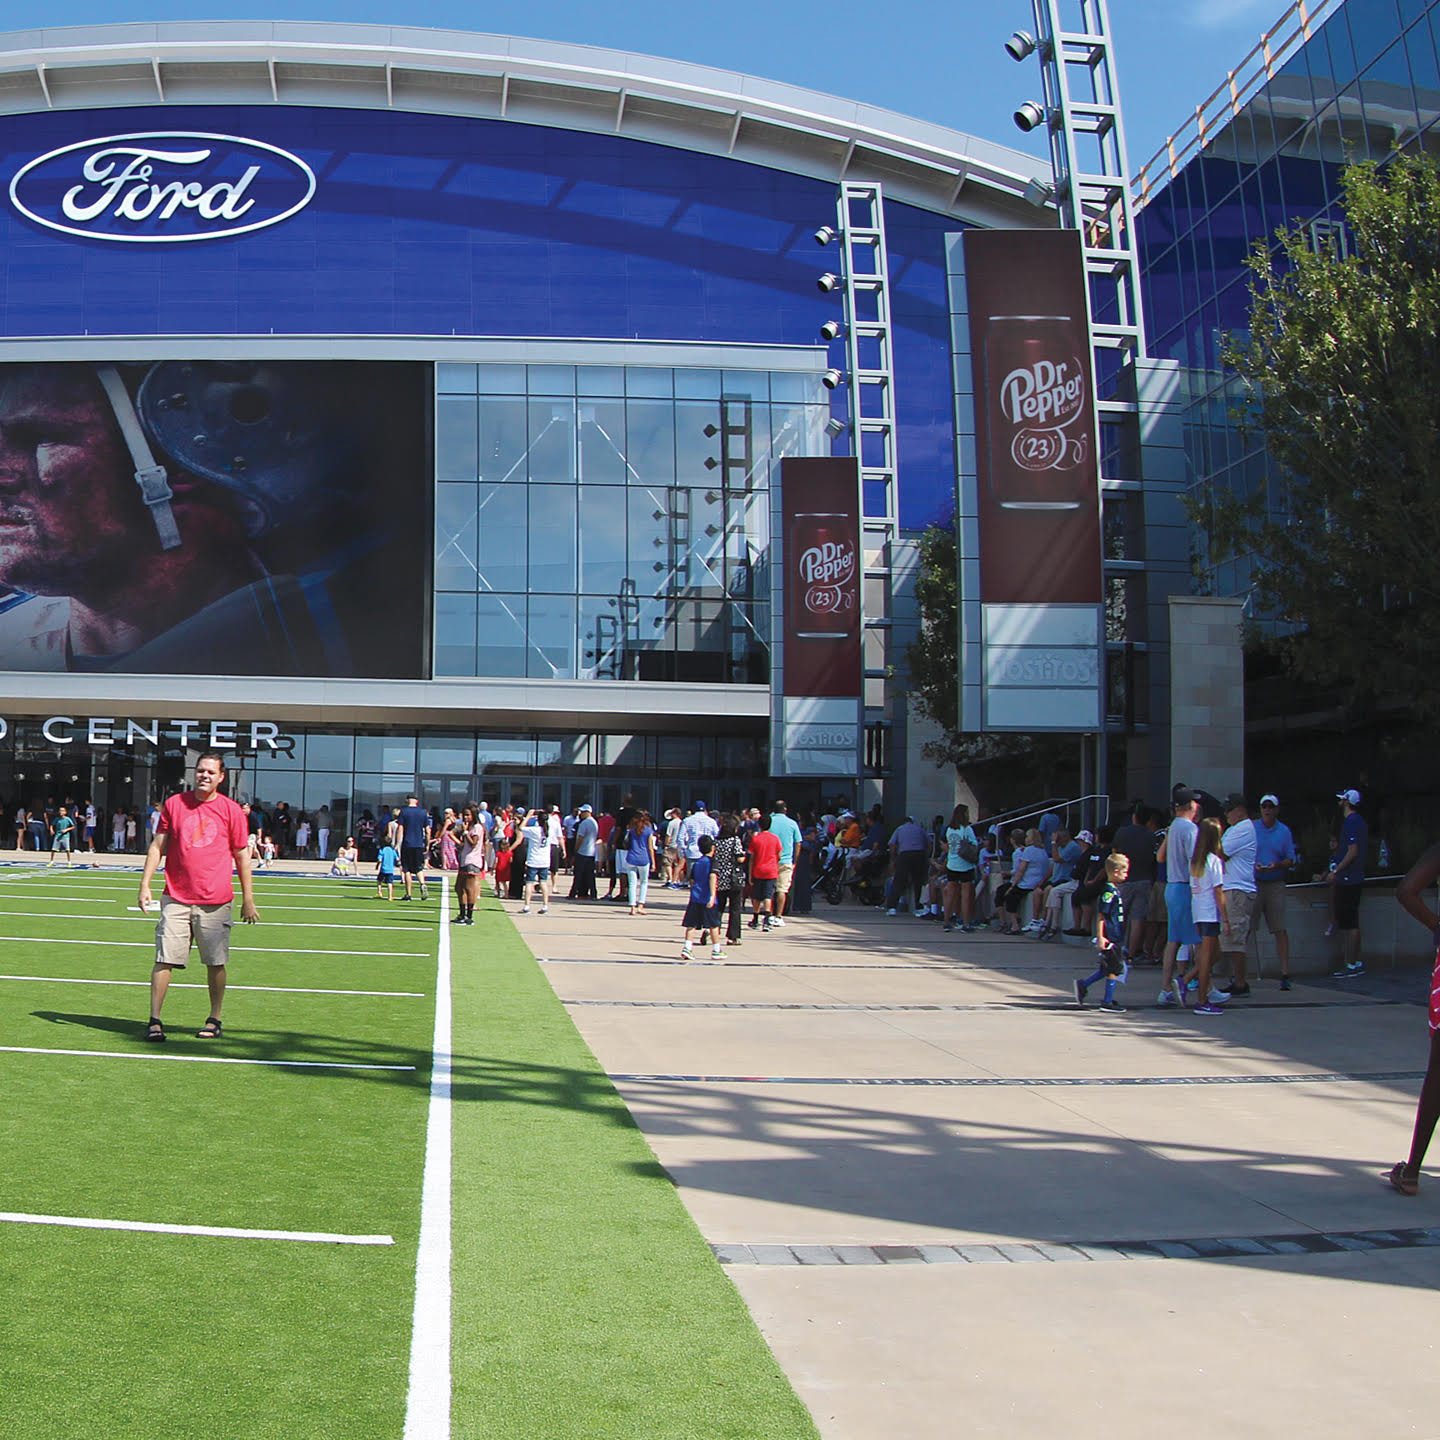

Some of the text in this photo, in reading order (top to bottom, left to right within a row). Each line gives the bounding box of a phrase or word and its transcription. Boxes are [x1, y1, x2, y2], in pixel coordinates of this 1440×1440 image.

[62, 147, 261, 221] Ford
[1033, 361, 1067, 393] Dr
[1000, 368, 1082, 424] Pepper
[1027, 437, 1049, 459] 23
[800, 547, 854, 583] Pepper
[822, 542, 844, 564] Dr
[815, 591, 830, 606] 23
[42, 716, 279, 749] CENTER
